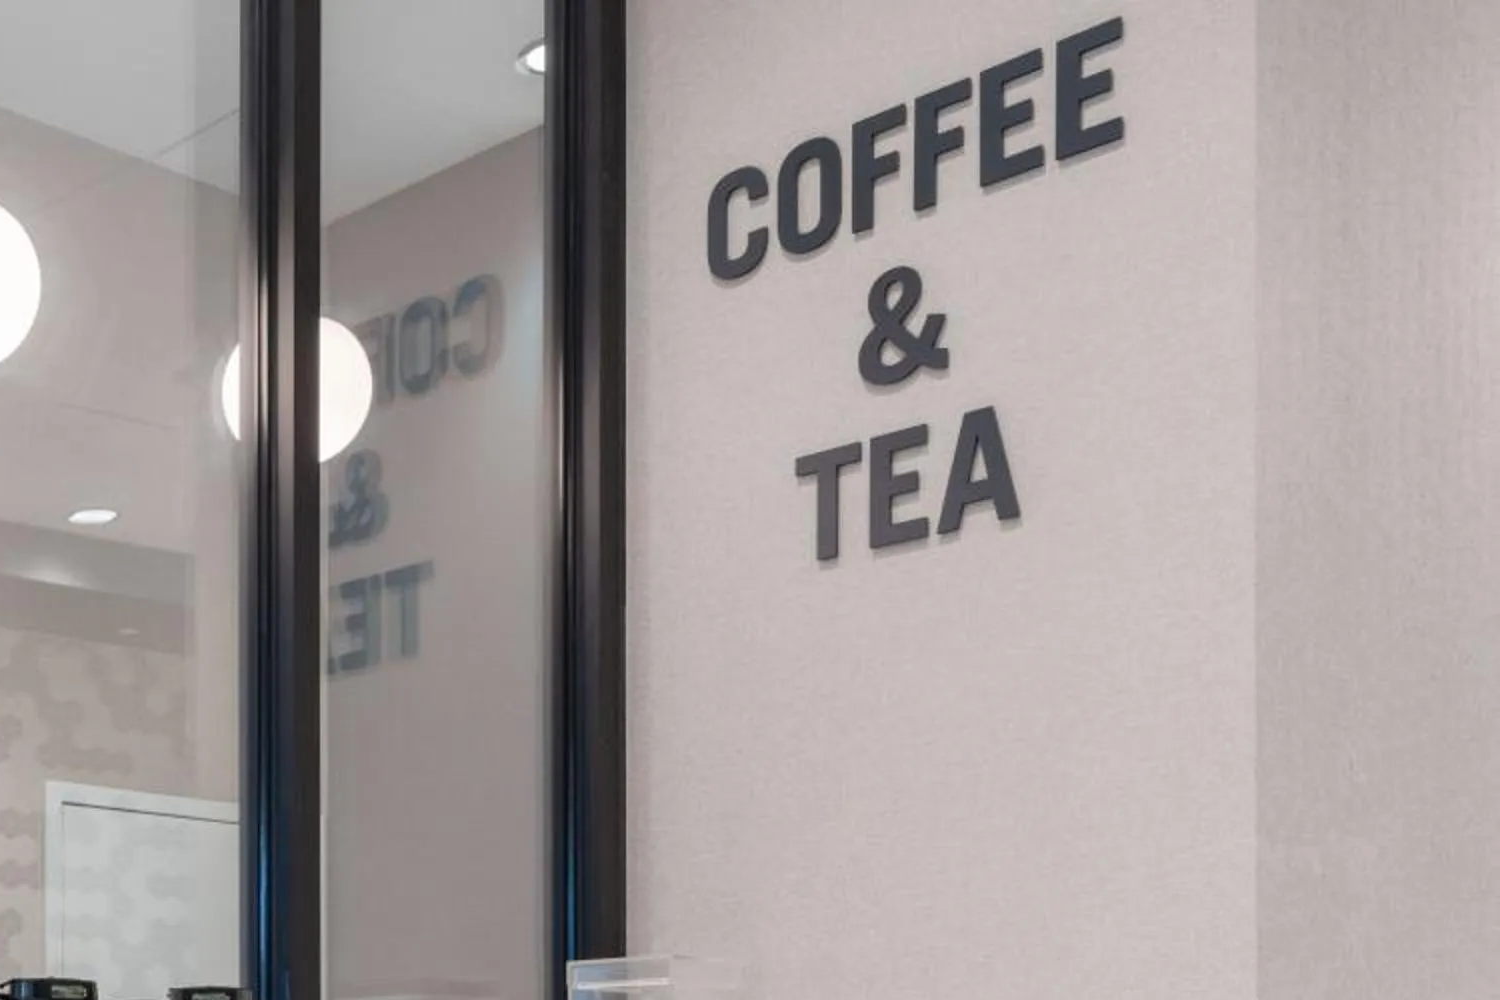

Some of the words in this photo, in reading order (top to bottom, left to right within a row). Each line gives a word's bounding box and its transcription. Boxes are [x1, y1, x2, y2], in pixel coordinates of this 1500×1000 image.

[707, 16, 1124, 281] COFFEE
[858, 266, 949, 386] &
[795, 405, 1021, 562] TEA
